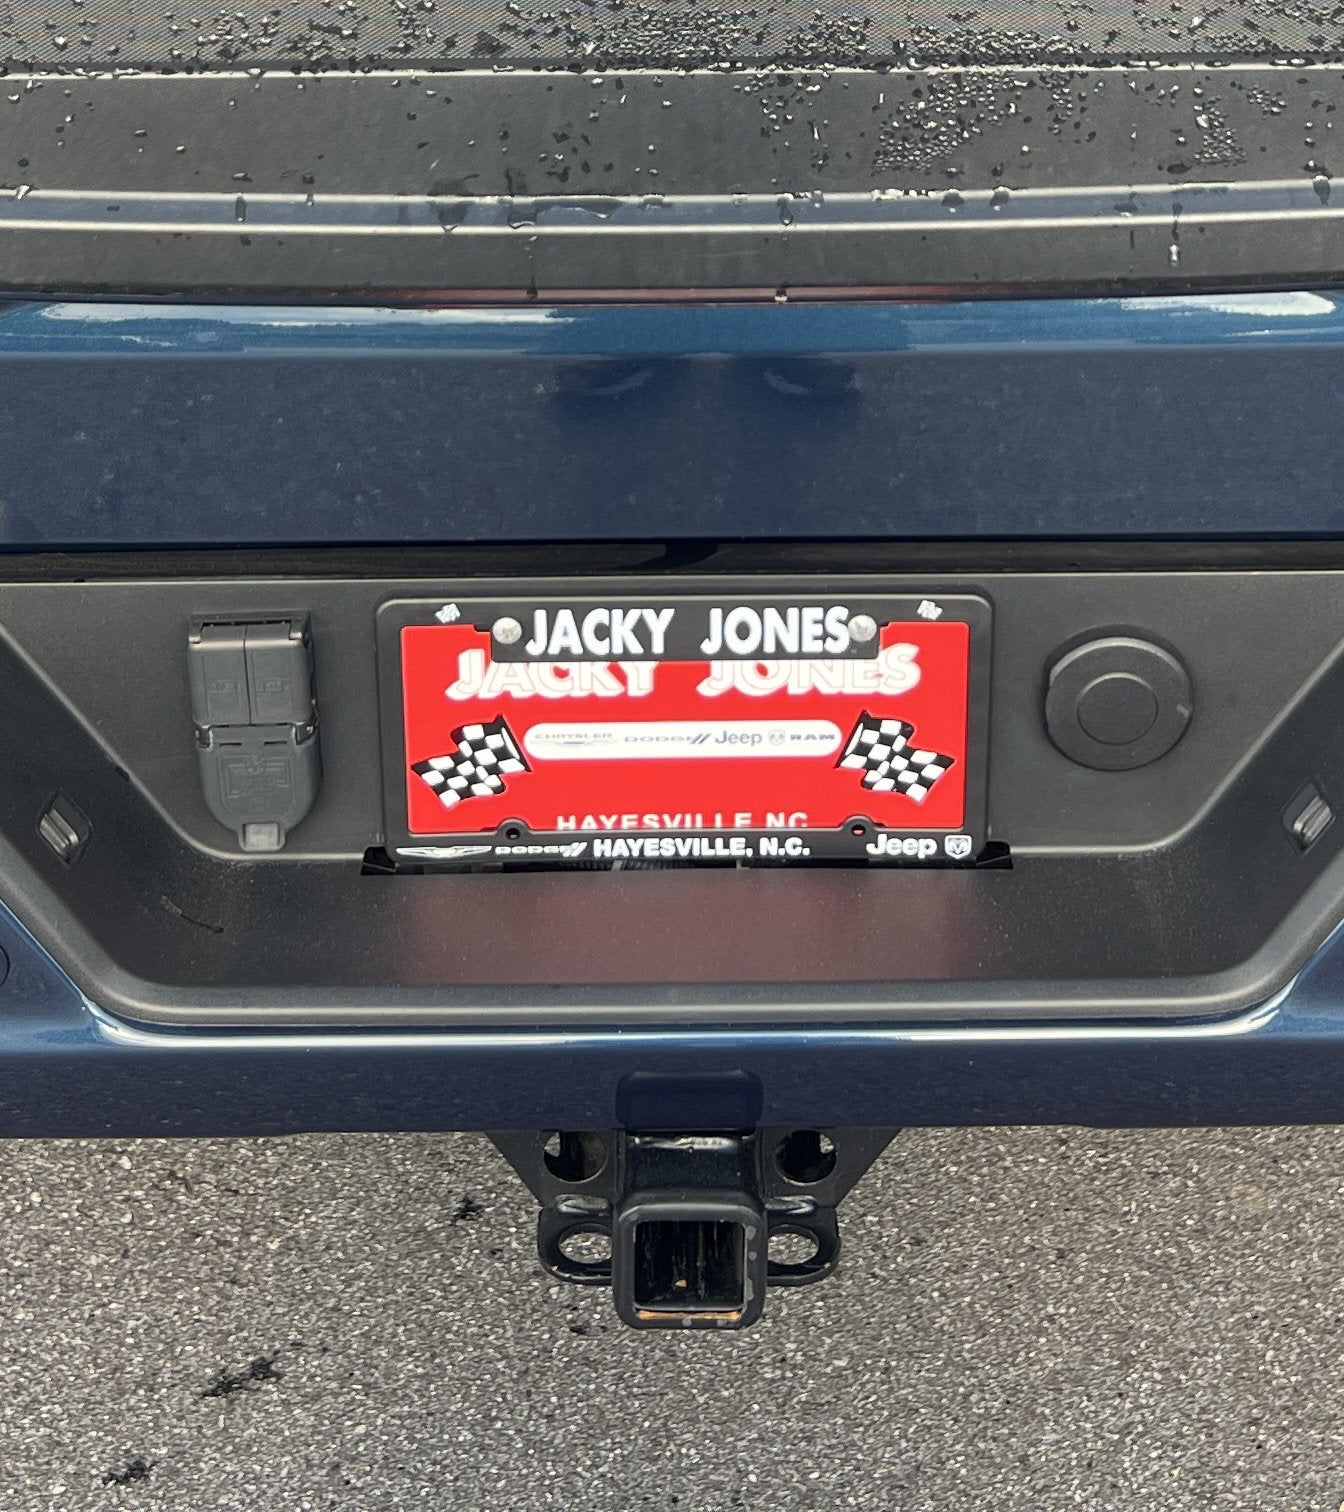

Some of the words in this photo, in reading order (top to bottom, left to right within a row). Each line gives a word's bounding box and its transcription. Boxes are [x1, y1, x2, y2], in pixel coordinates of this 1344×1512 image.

[525, 607, 676, 656] JACKY
[700, 606, 851, 655] JONES
[445, 648, 660, 700] JACKY
[696, 643, 922, 697] JONES
[714, 729, 763, 747] Jeep
[593, 837, 754, 858] HAYESVILLE,
[759, 836, 811, 857] N.C.
[865, 833, 938, 859] Jeep
